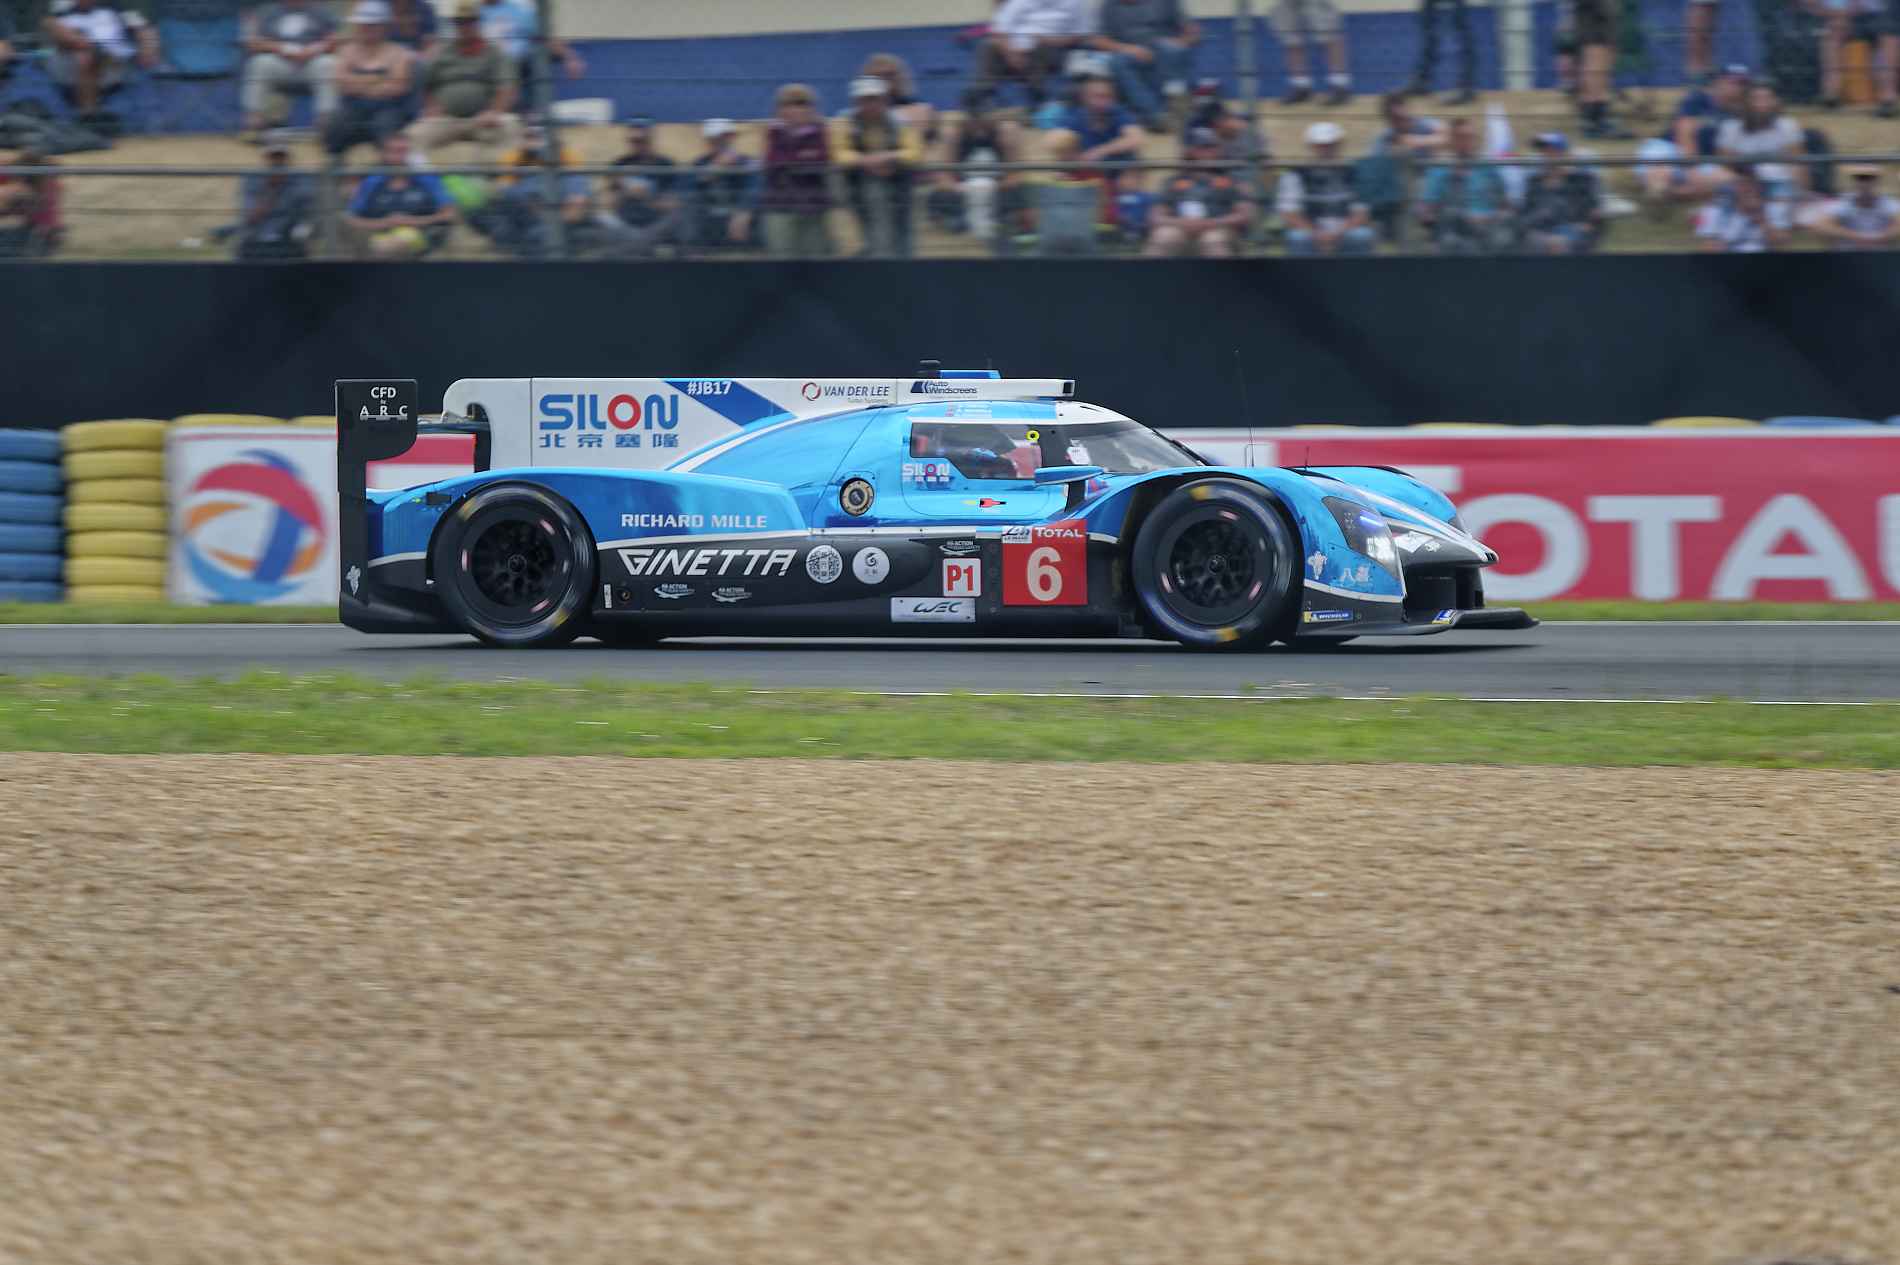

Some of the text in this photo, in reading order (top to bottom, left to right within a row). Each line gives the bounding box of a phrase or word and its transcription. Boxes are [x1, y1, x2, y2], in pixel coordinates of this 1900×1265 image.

[371, 386, 397, 398] CFD
[686, 381, 733, 395] #JB17
[824, 386, 889, 396] VAN DER LEE
[928, 386, 977, 394] Windscreens
[539, 394, 679, 430] SILON
[902, 463, 950, 477] SILON
[621, 513, 768, 528] RICHARD MILLE
[1034, 526, 1084, 538] TOTAL
[1395, 465, 1900, 600] OTA
[617, 549, 797, 576] GINETTA
[947, 565, 974, 592] P1
[1027, 546, 1063, 602] 6
[912, 601, 963, 613] WEC
